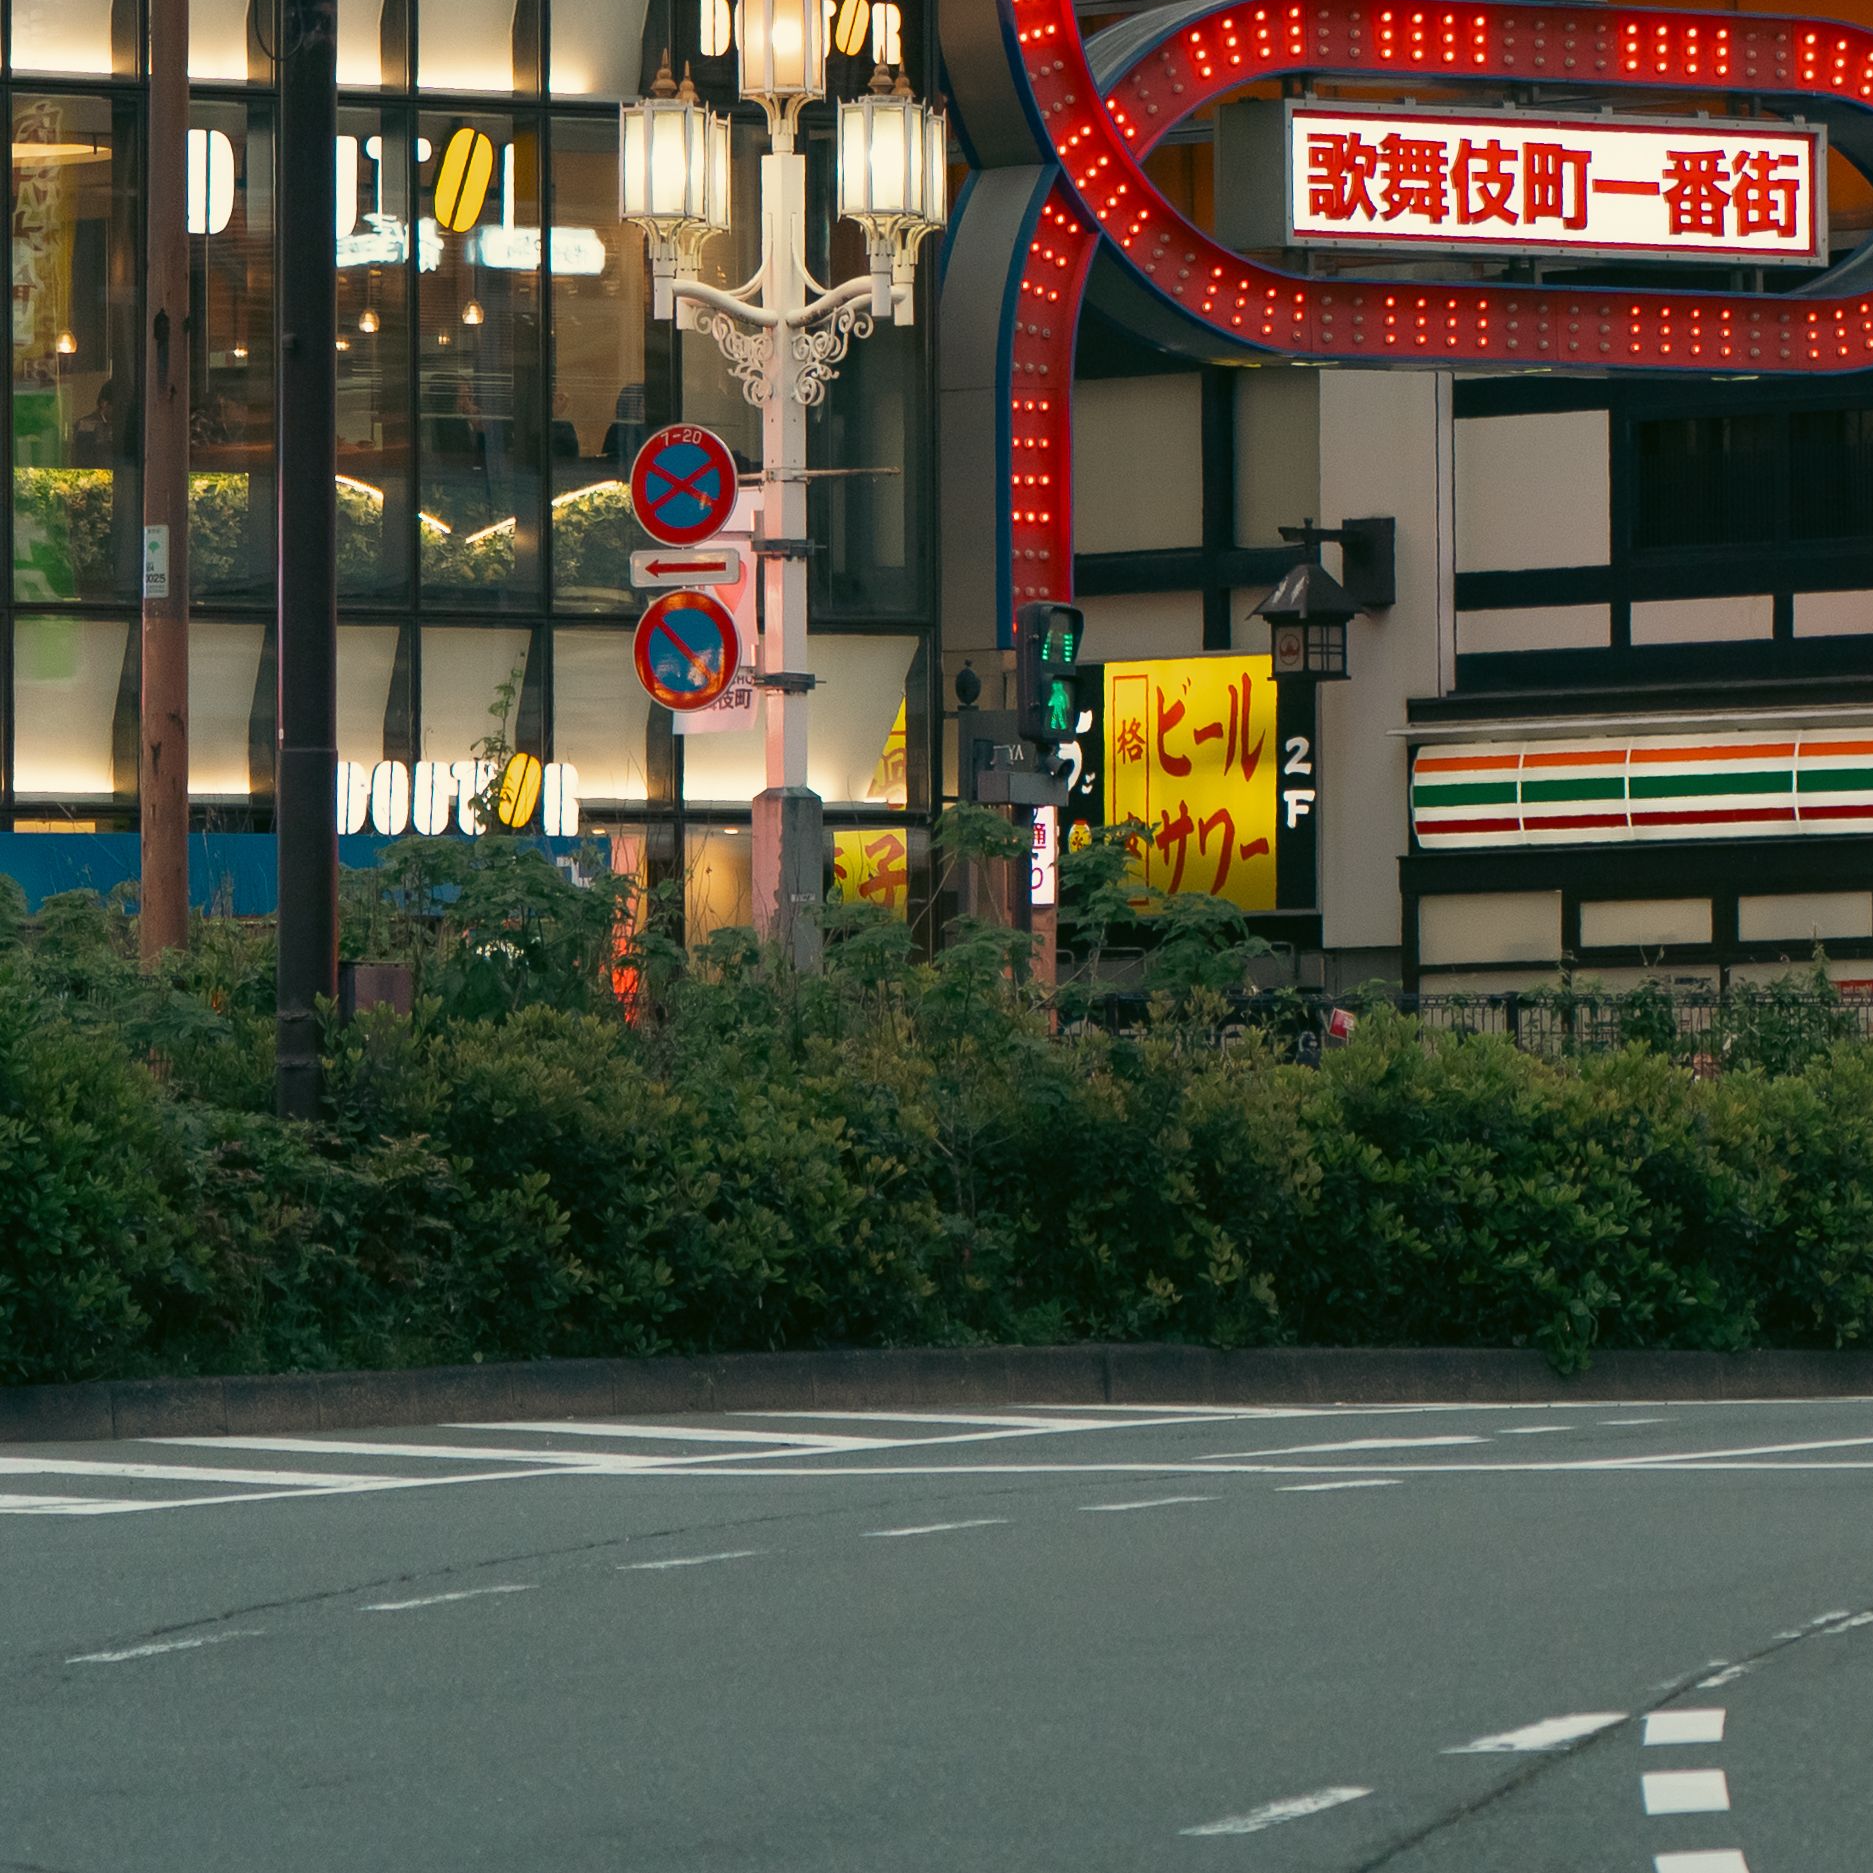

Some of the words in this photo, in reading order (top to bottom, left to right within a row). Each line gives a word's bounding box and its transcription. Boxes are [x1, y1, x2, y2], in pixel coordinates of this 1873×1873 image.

[1308, 131, 1800, 237] 歌舞伎町一番街
[1156, 672, 1266, 782] ビール
[1156, 799, 1271, 896] サワー
